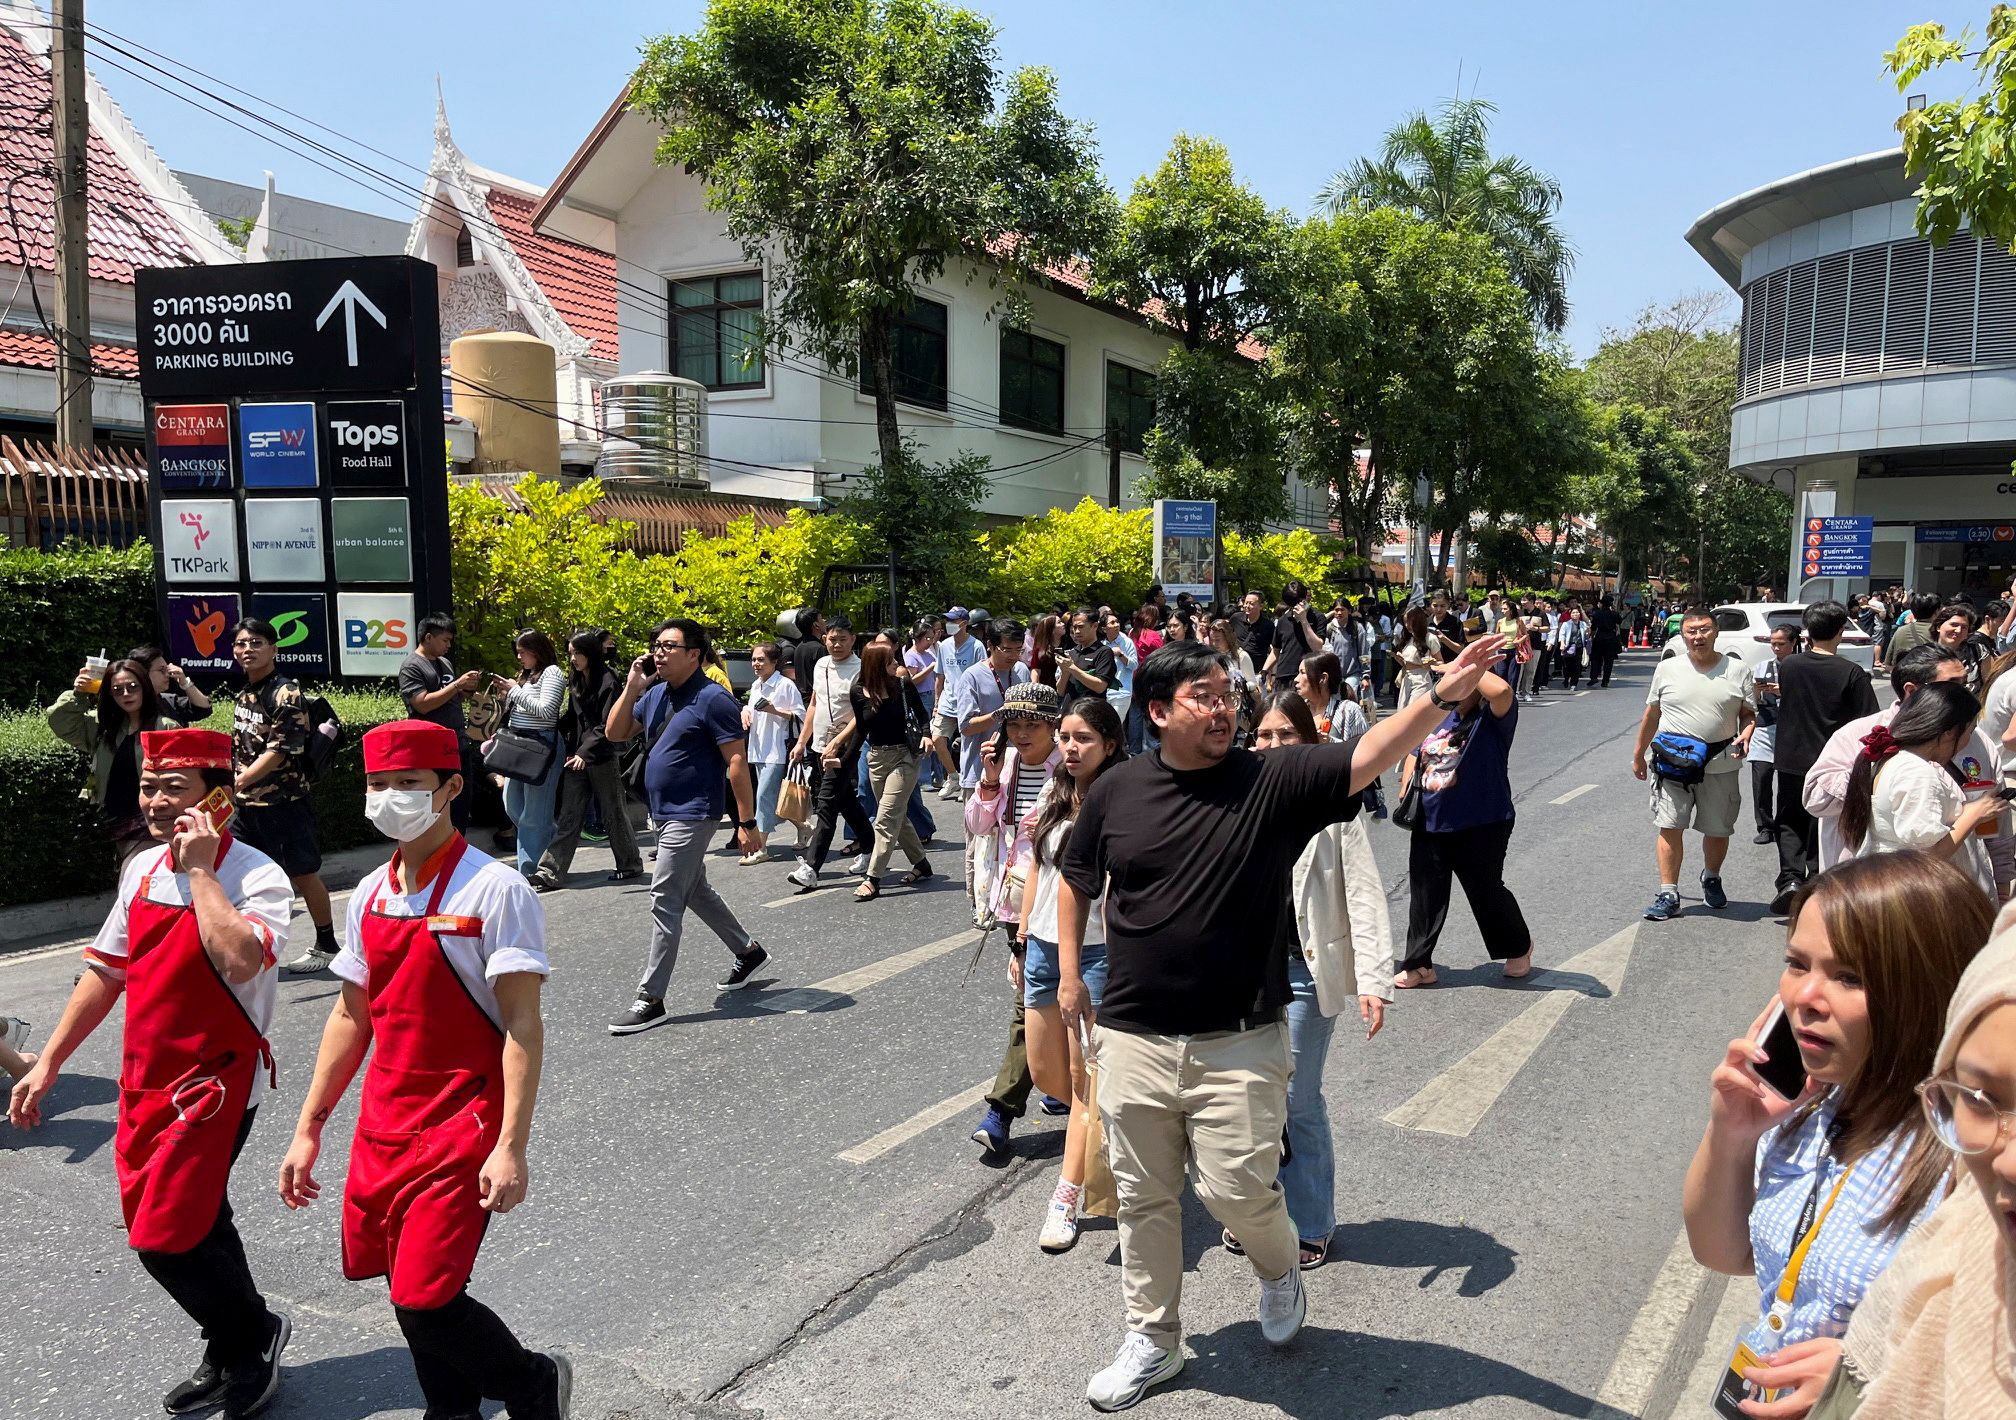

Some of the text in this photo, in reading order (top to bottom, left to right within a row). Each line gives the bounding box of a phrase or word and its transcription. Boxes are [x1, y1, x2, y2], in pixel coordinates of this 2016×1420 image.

[153, 292, 292, 316] อาคารจอดรถ
[154, 318, 250, 346] 3000 คัน
[156, 350, 294, 370] PARKING BUILDING
[157, 412, 225, 429] CENTARA
[330, 420, 398, 452] Tops
[160, 458, 226, 472] BANGKOK
[342, 456, 392, 468] Food Hall
[284, 540, 316, 549] AVENUE
[336, 538, 404, 546] urban balance
[344, 619, 408, 648] B2S
[180, 658, 233, 670] Power Buy
[273, 654, 323, 663] ERSPORTS
